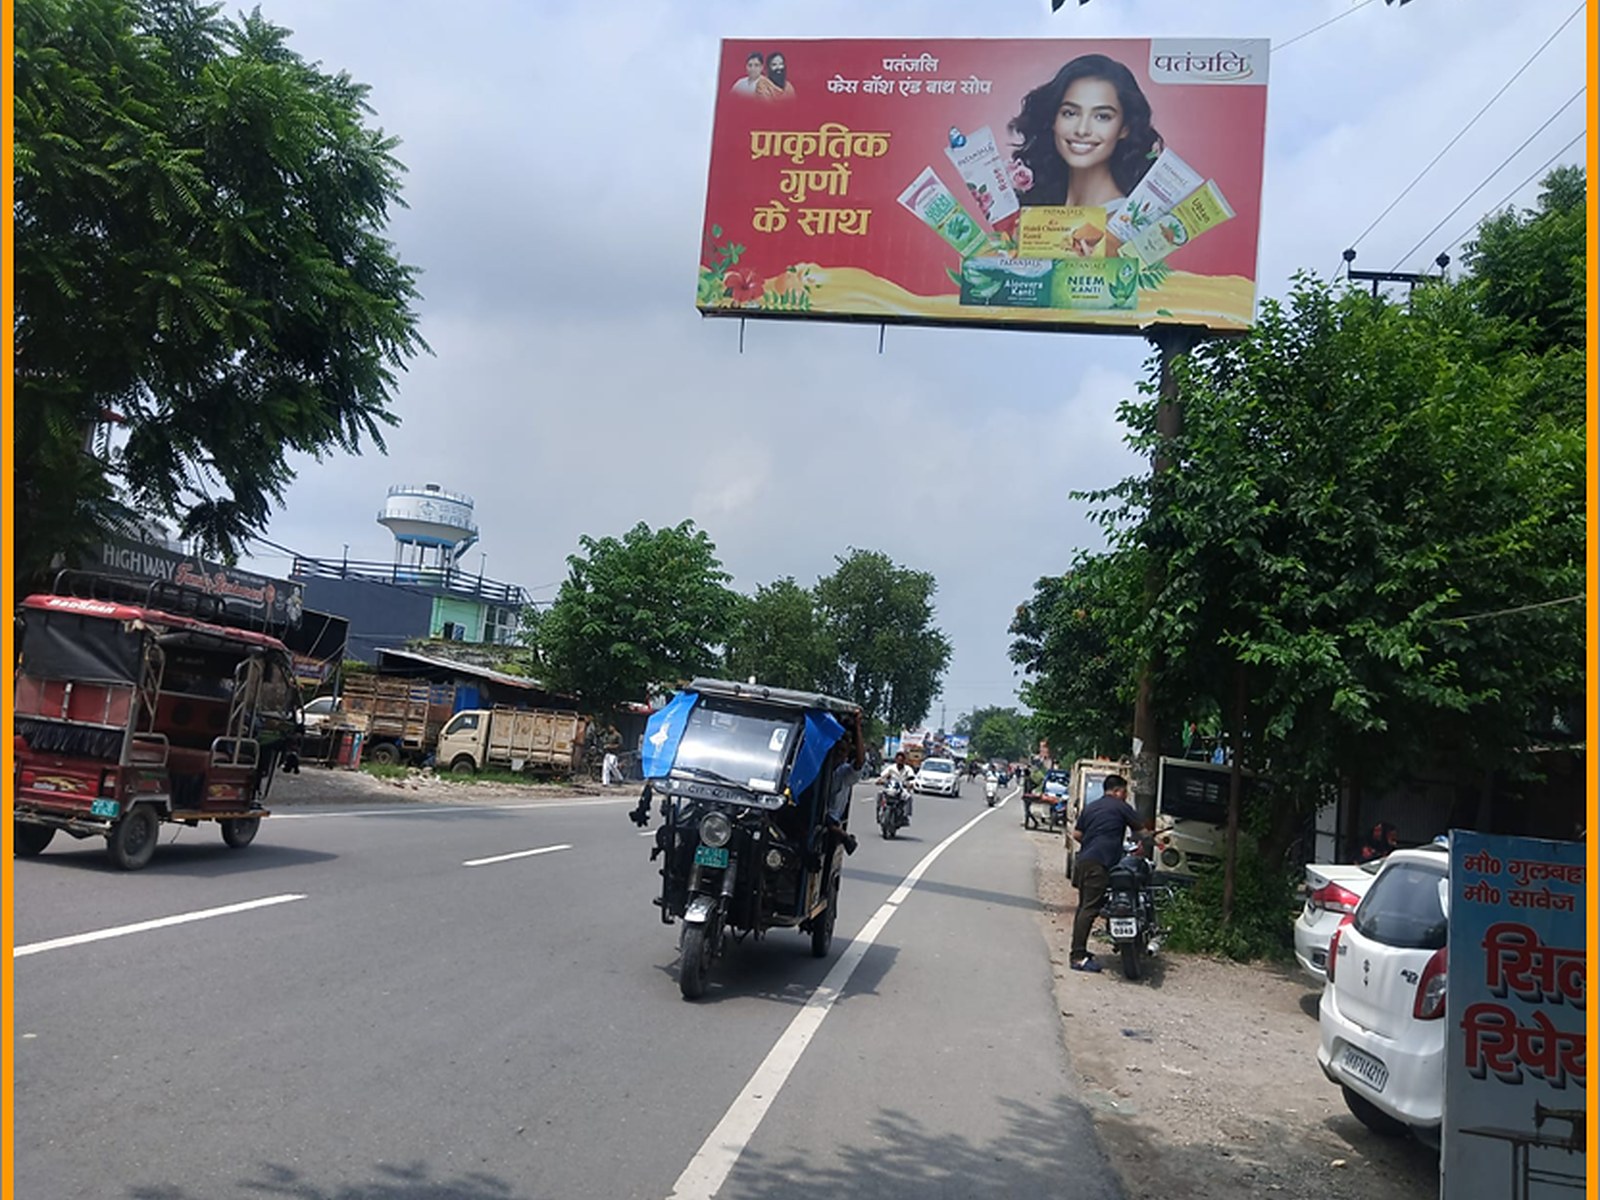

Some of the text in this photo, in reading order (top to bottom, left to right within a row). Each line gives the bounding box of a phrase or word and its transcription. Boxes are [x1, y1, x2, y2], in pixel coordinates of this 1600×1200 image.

[883, 55, 938, 73] पतंजलि
[1155, 50, 1247, 74] पतंजलि
[828, 75, 992, 96] फेस वॉश एंड बाथ सोप
[750, 122, 891, 164] प्राकृतिक
[779, 162, 852, 203] गुणों
[752, 200, 872, 236] के साथ
[1010, 286, 1036, 296] Kanti
[1067, 276, 1105, 287] NEEM
[1071, 286, 1102, 294] KANTI
